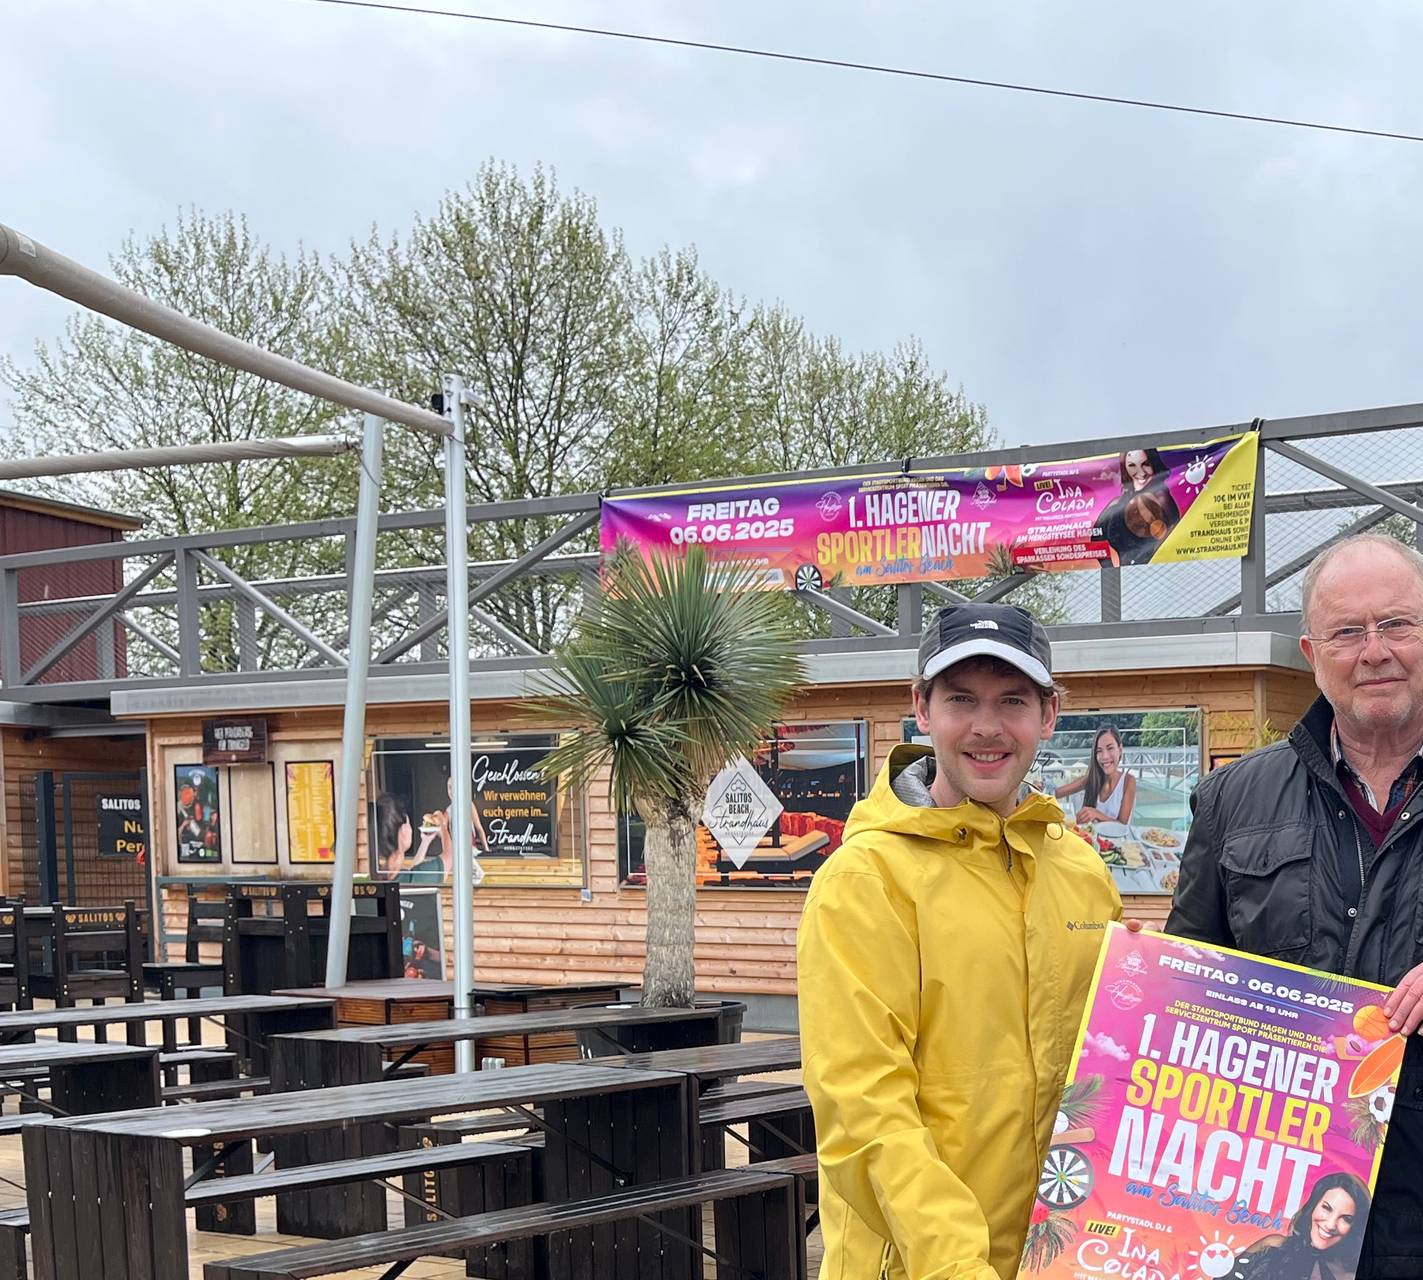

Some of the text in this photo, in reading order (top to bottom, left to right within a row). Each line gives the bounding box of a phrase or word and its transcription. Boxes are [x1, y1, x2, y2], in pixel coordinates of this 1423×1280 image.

[1036, 481, 1052, 490] LIVE!
[1232, 483, 1251, 491] TICKET
[687, 497, 780, 523] FREITAG
[848, 495, 863, 528] 1.
[865, 490, 961, 527] HAGENER
[669, 518, 795, 545] 06.06.2025
[1016, 534, 1028, 543] AM
[1076, 527, 1103, 538] HAGEN
[1027, 520, 1092, 535] STRANDHAUS
[1190, 528, 1232, 538] STRANDHAUS
[1073, 544, 1086, 552] DES
[856, 564, 872, 577] am
[484, 789, 547, 801] Wir verwöhnen
[725, 792, 753, 804] SALITOS
[101, 798, 142, 811] SALITOS
[728, 803, 750, 815] BEACH
[483, 806, 504, 817] euch
[505, 808, 530, 820] gerne
[487, 818, 549, 846] Strandhaus
[78, 912, 115, 923] SALITOS
[1158, 954, 1239, 985] FREITAG
[1247, 979, 1354, 1014] 06.06.2025
[1206, 990, 1299, 1019] EINLASS AB 18 UHR
[1165, 1006, 1231, 1029] SERVICEZENTRUM
[1232, 1023, 1257, 1036] SPORT
[1174, 1000, 1322, 1044] DER STADTSPORTBUND HAGEN UND DAS
[1137, 1012, 1340, 1104] 1. HAGENER
[1125, 1058, 1332, 1153] SPORTLER
[1107, 1104, 1323, 1221] NACHT
[1125, 1181, 1284, 1231] am Salitos Beach
[1106, 1210, 1154, 1229] PARTYSTADL
[1087, 1222, 1117, 1236] LIVE!
